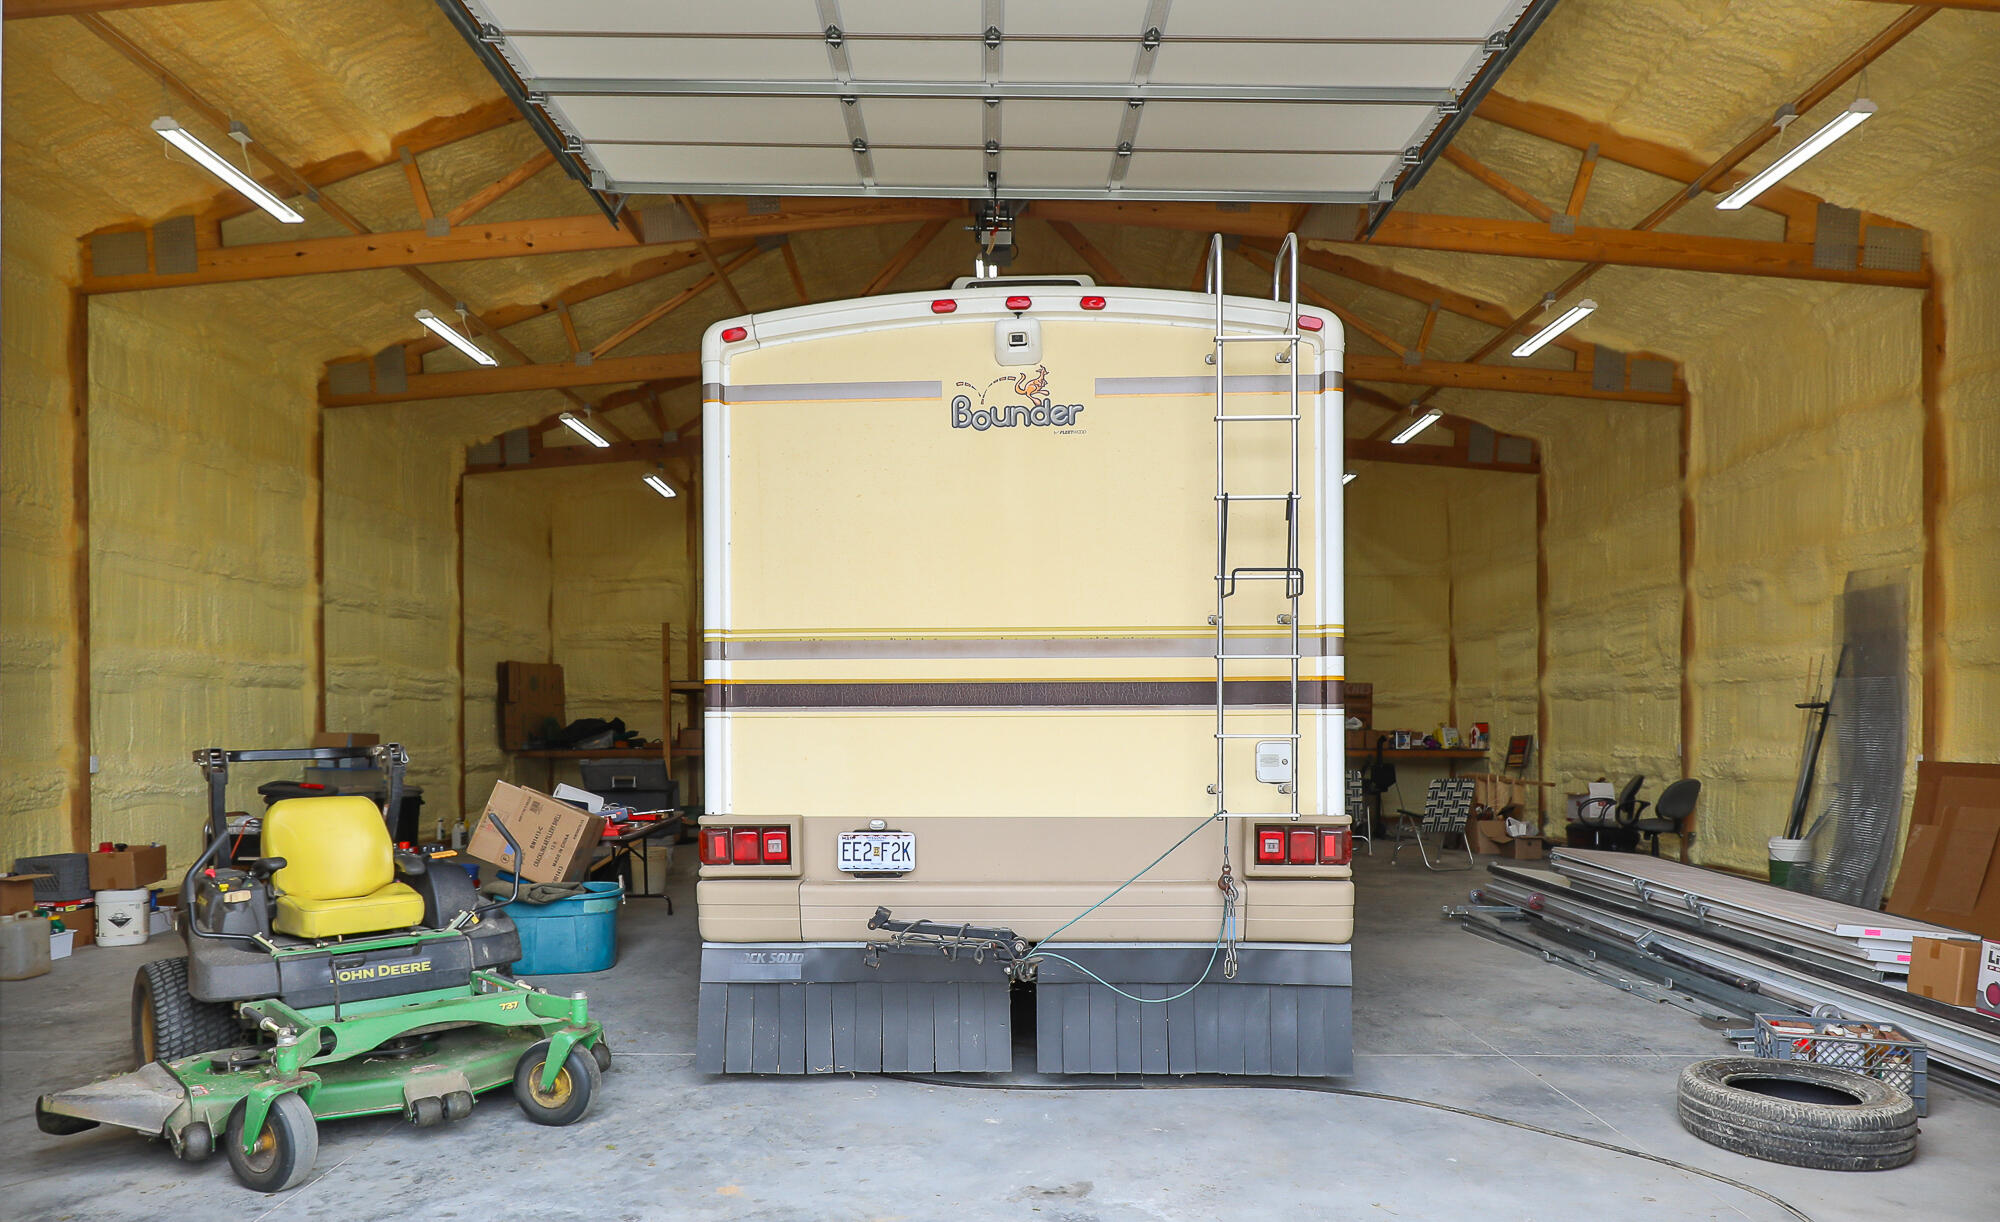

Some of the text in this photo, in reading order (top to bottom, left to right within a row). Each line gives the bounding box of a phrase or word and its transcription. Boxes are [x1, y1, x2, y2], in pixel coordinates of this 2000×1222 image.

[951, 394, 1084, 431] Bounder
[551, 852, 561, 867] MADE
[559, 833, 570, 849] CHINA
[842, 841, 911, 862] EE2 F2K
[768, 952, 804, 964] SOLID
[378, 961, 432, 977] DEERE
[498, 1001, 519, 1012] 737
